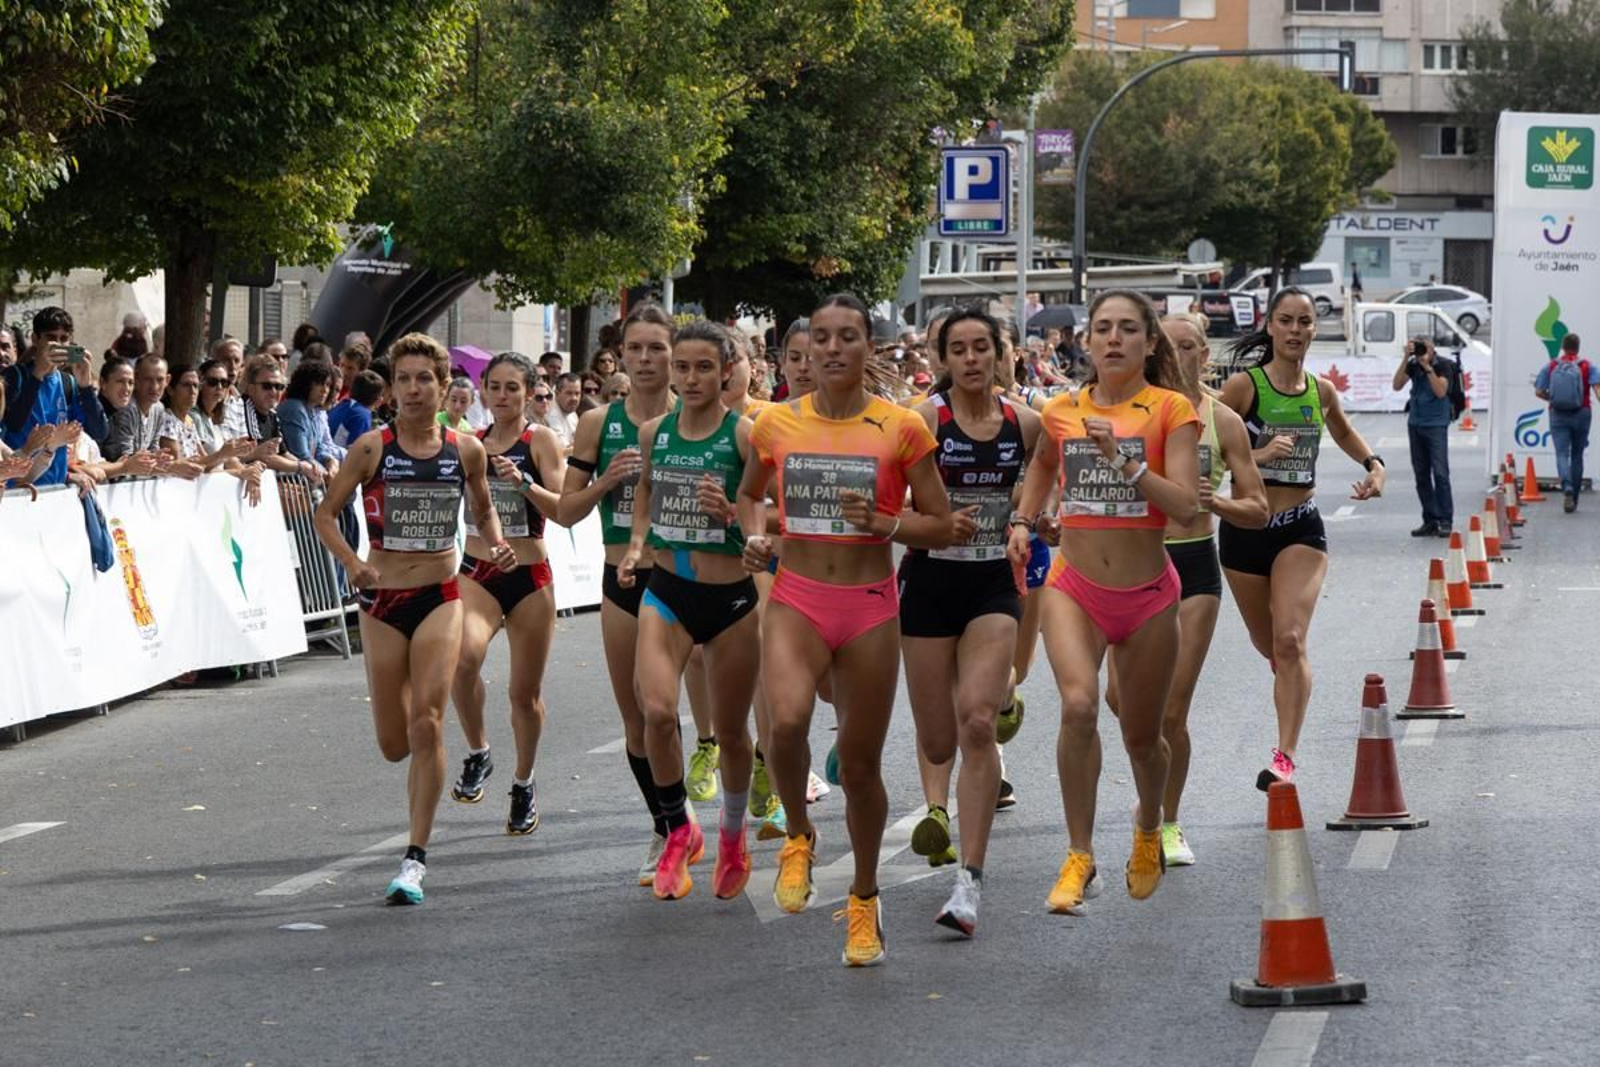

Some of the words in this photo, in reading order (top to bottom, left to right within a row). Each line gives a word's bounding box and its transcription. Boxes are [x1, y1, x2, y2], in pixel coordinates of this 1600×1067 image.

[1556, 164, 1589, 175] RURAL
[954, 157, 993, 199] P
[957, 220, 990, 230] LIBRE
[1332, 217, 1440, 231] TALDENT
[1518, 249, 1597, 263] Ayuntamiento
[1534, 261, 1549, 272] de
[1550, 260, 1579, 272] Jaén
[1261, 426, 1274, 436] 36
[1064, 442, 1078, 456] 36
[787, 456, 803, 470] 36
[804, 461, 835, 471] Manuel
[651, 469, 663, 481] 36
[978, 472, 1003, 484] BM
[1078, 468, 1125, 485] CARLA
[388, 487, 402, 498] 36
[676, 485, 691, 497] 30
[785, 484, 811, 500] ANA
[1070, 486, 1136, 502] GALLARDO
[417, 499, 431, 510] 33
[391, 509, 453, 524] CAROLINA
[659, 512, 710, 529] MITJANS
[401, 525, 446, 538] ROBLES
